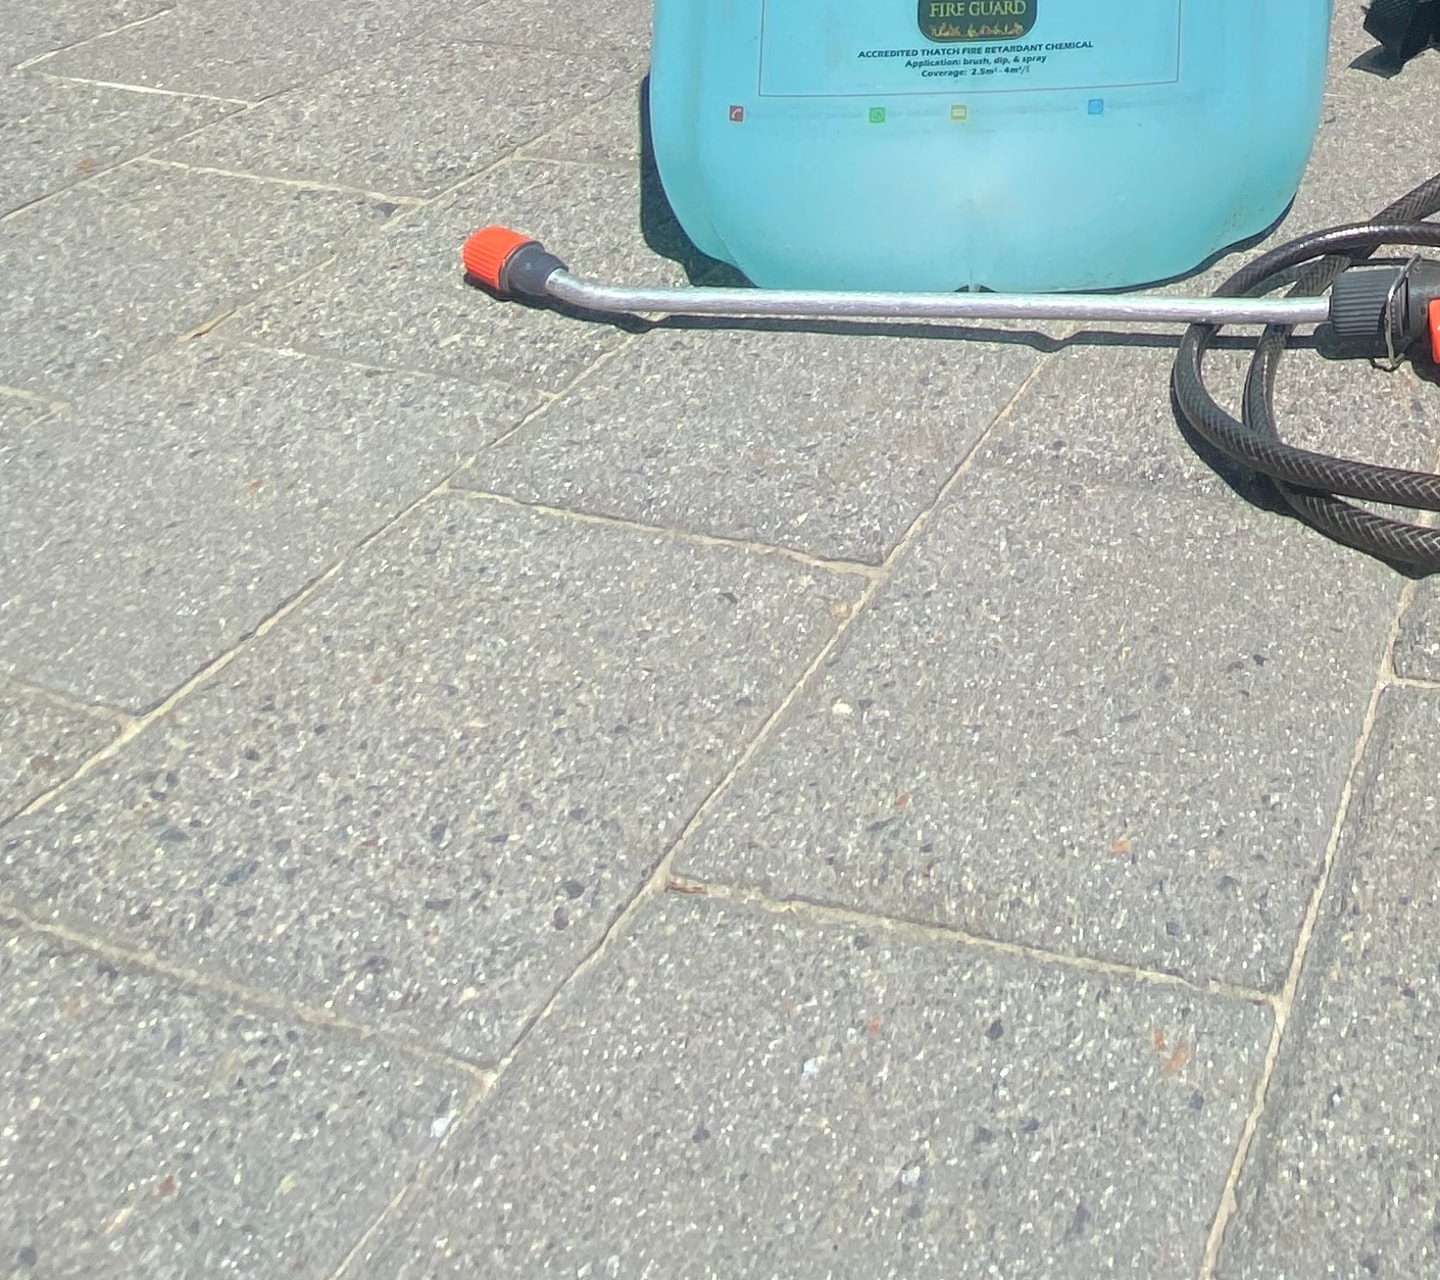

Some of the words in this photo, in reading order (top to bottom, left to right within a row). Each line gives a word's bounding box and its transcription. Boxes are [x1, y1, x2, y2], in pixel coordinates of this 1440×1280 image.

[929, 1, 966, 18] FIRE
[969, 0, 1027, 17] GUARD
[857, 49, 919, 59] ACCREDITED
[921, 47, 960, 57] THATCH
[962, 46, 983, 56] FIRE
[984, 44, 1043, 55] RETARDANT
[1045, 41, 1094, 51] CHEMICAL
[904, 58, 961, 69] Application:
[963, 57, 992, 67] brush,
[1012, 55, 1020, 63] &
[1022, 54, 1047, 65] spray
[921, 68, 967, 78] Coverage:
